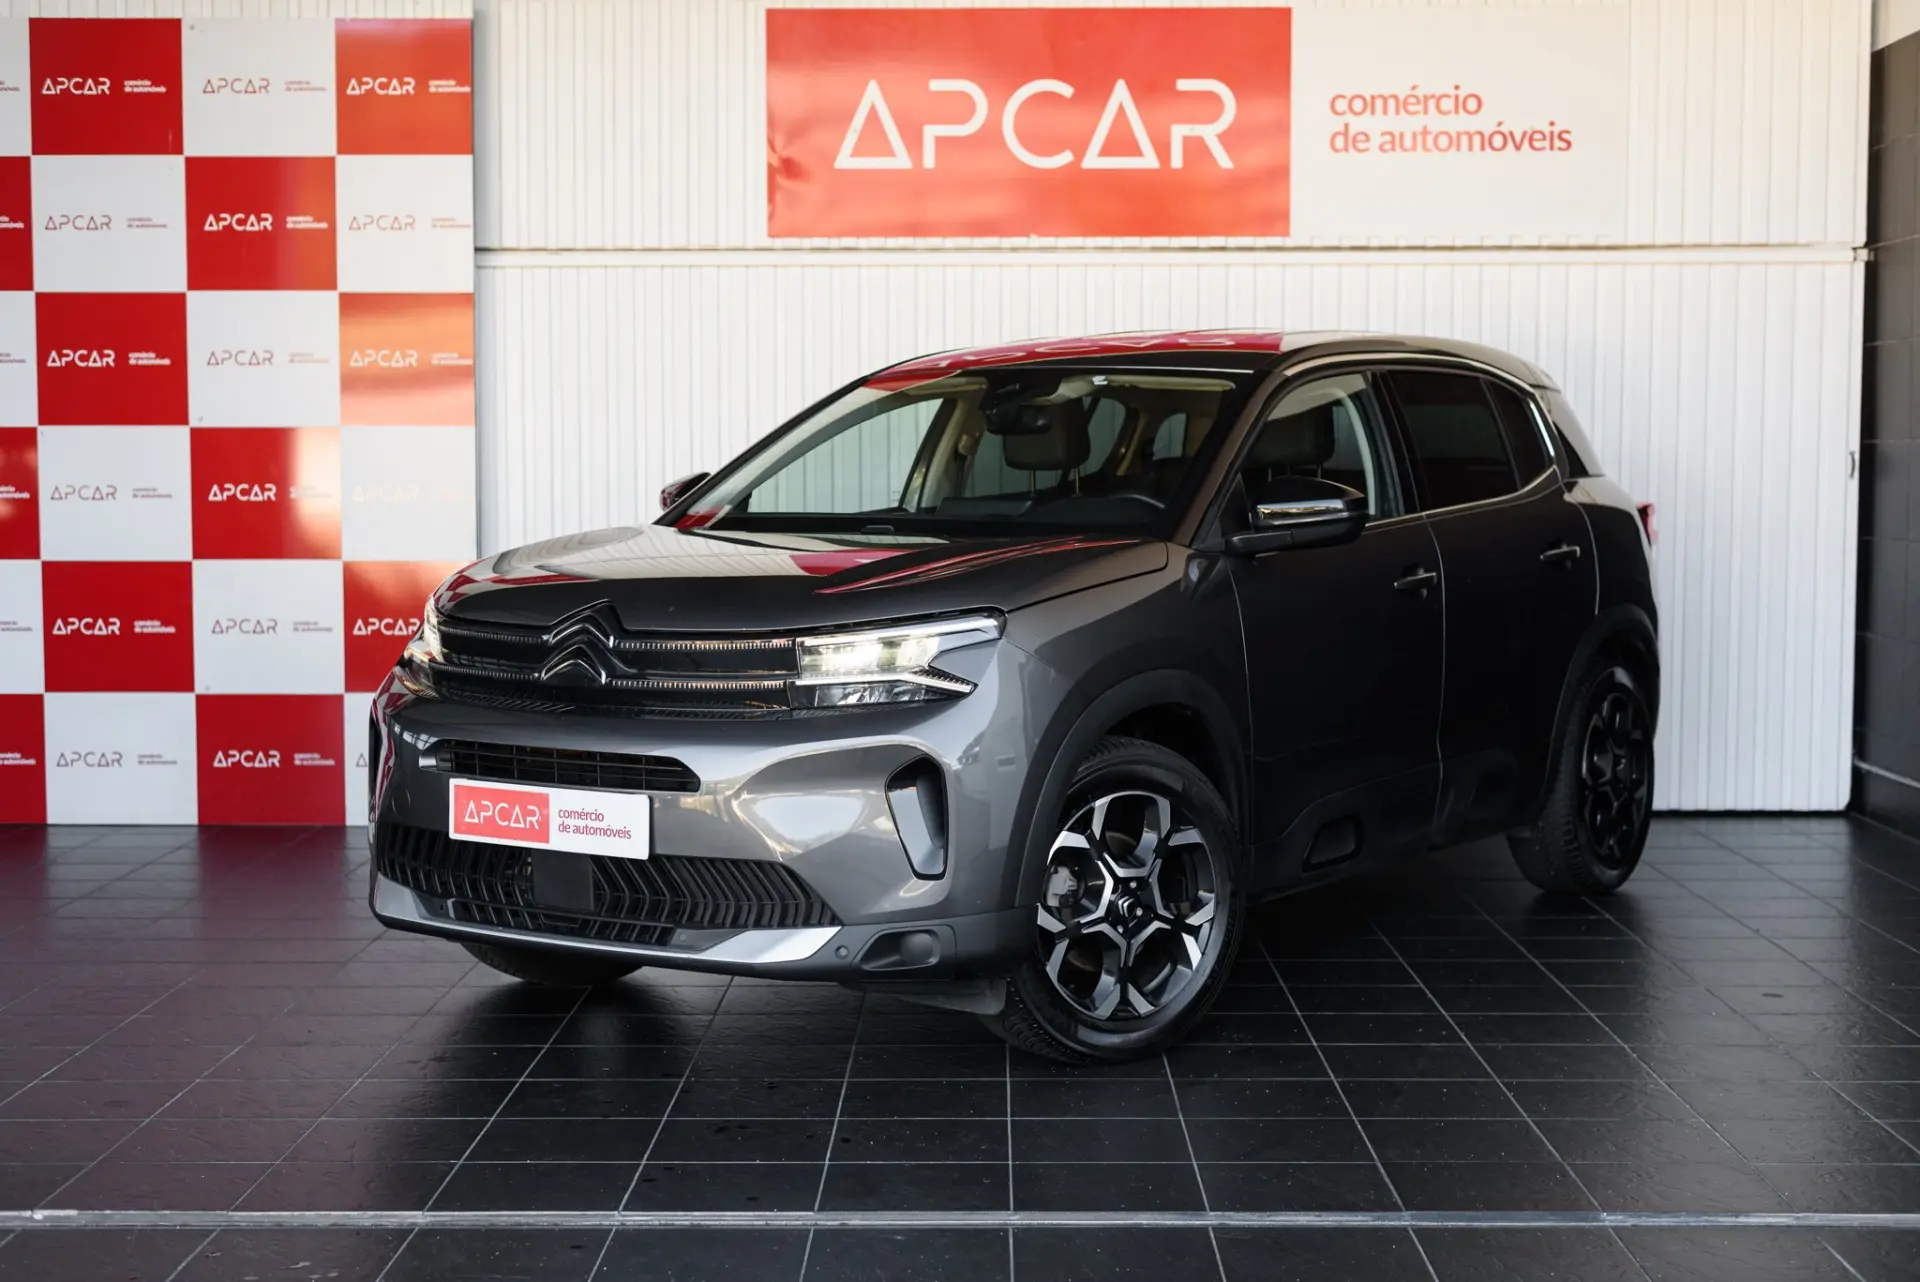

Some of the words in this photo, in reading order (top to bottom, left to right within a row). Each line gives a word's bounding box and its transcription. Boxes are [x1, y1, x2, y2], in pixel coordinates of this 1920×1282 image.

[42, 78, 110, 95] APCAR
[202, 78, 270, 94] APCAR
[346, 77, 415, 95] APCAR
[1330, 85, 1483, 116] comércio
[834, 79, 1237, 168] APCAR
[1330, 123, 1371, 153] de
[1379, 121, 1572, 153] automóveis
[44, 214, 112, 231] APCAR
[204, 213, 273, 231] APCAR
[349, 215, 416, 231] APCAR
[47, 350, 115, 367] APCAR
[207, 350, 274, 366] APCAR
[349, 349, 419, 368] APCAR
[50, 485, 117, 501] APCAR
[208, 483, 276, 501] APCAR
[53, 618, 120, 635] APCAR
[211, 618, 278, 634] APCAR
[56, 751, 123, 767] APCAR
[213, 750, 280, 767] APCAR
[464, 800, 540, 829] APCAR
[558, 807, 604, 822] comércio
[558, 821, 571, 834] de
[572, 824, 632, 839] automóveis
